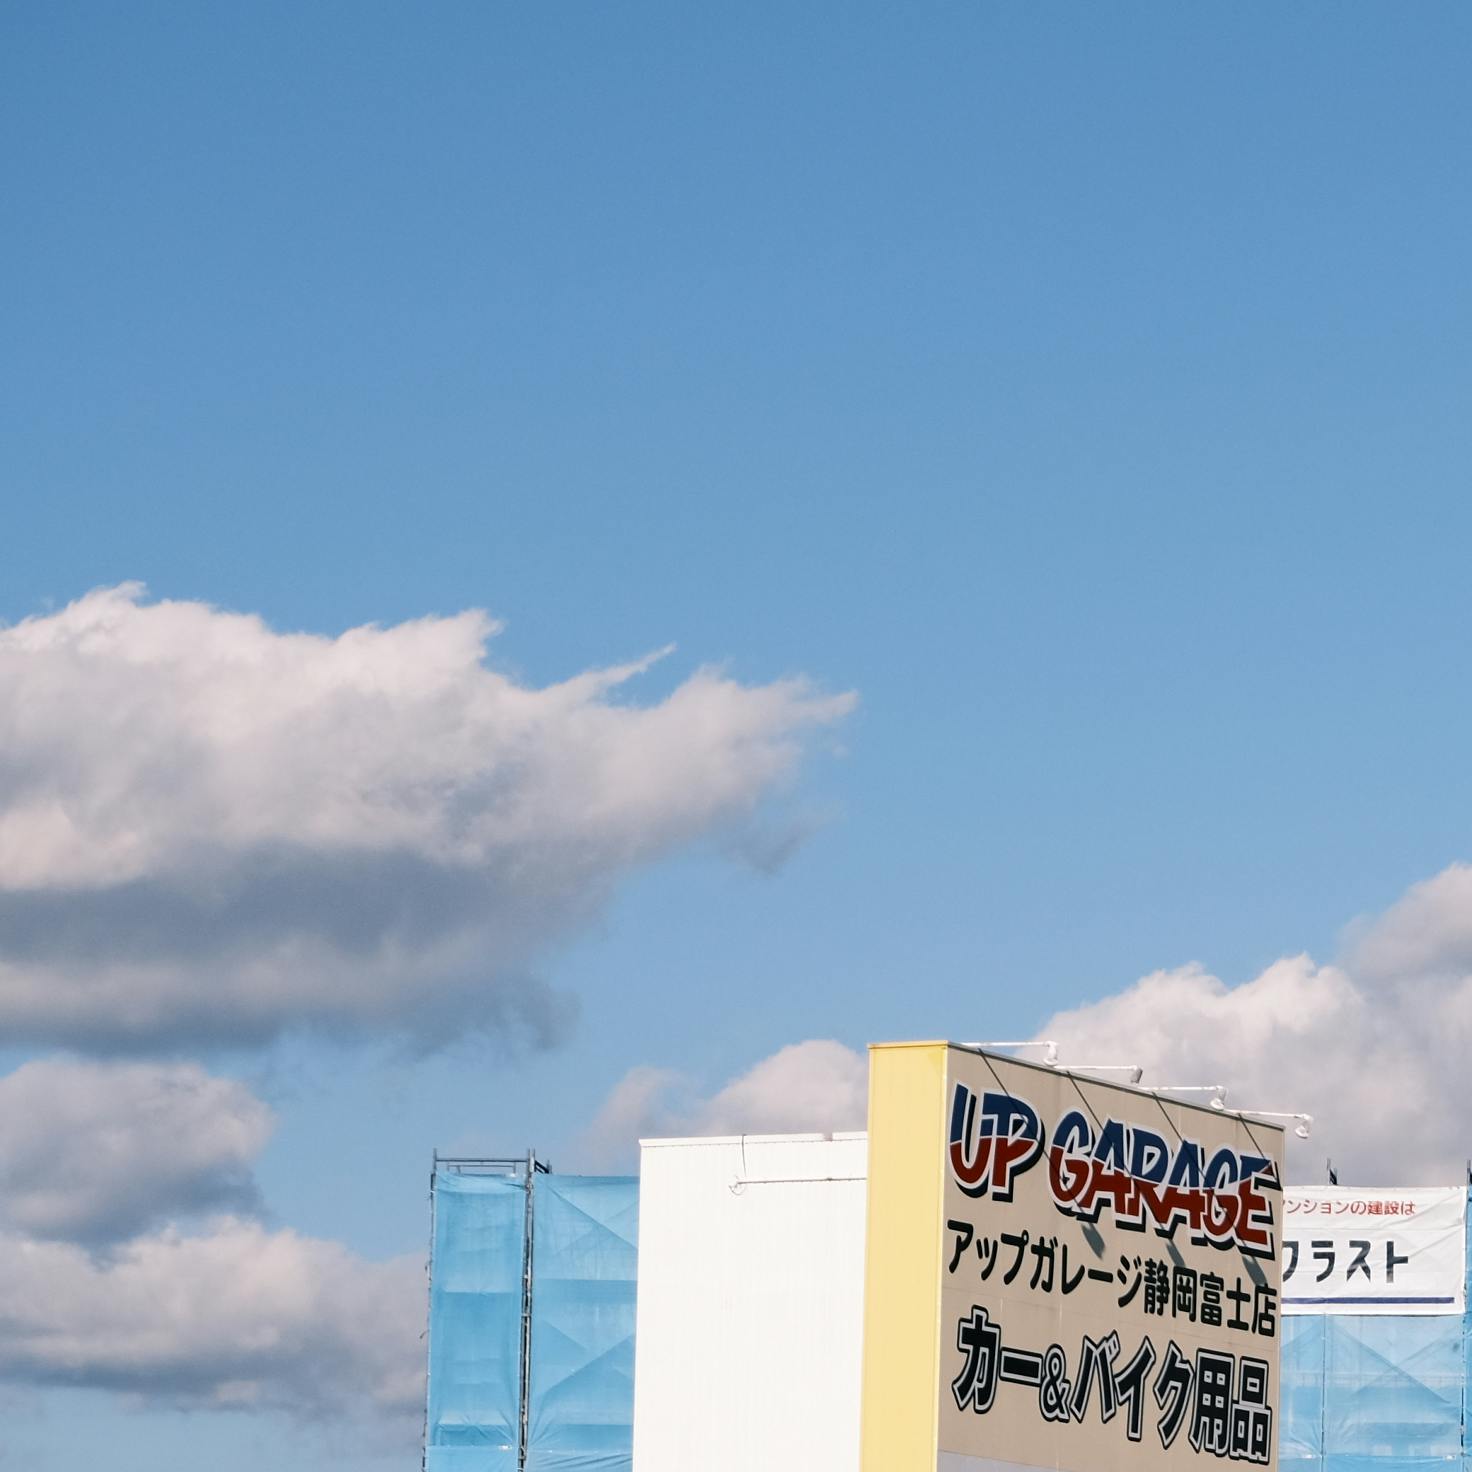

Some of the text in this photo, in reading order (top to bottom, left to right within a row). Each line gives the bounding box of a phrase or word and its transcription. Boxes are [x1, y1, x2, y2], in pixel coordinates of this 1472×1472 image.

[948, 1081, 1283, 1260] UP GARAGE
[1283, 1199, 1416, 1216] ンションの建設は
[947, 1219, 1277, 1337] アップガレージ静岡富士店
